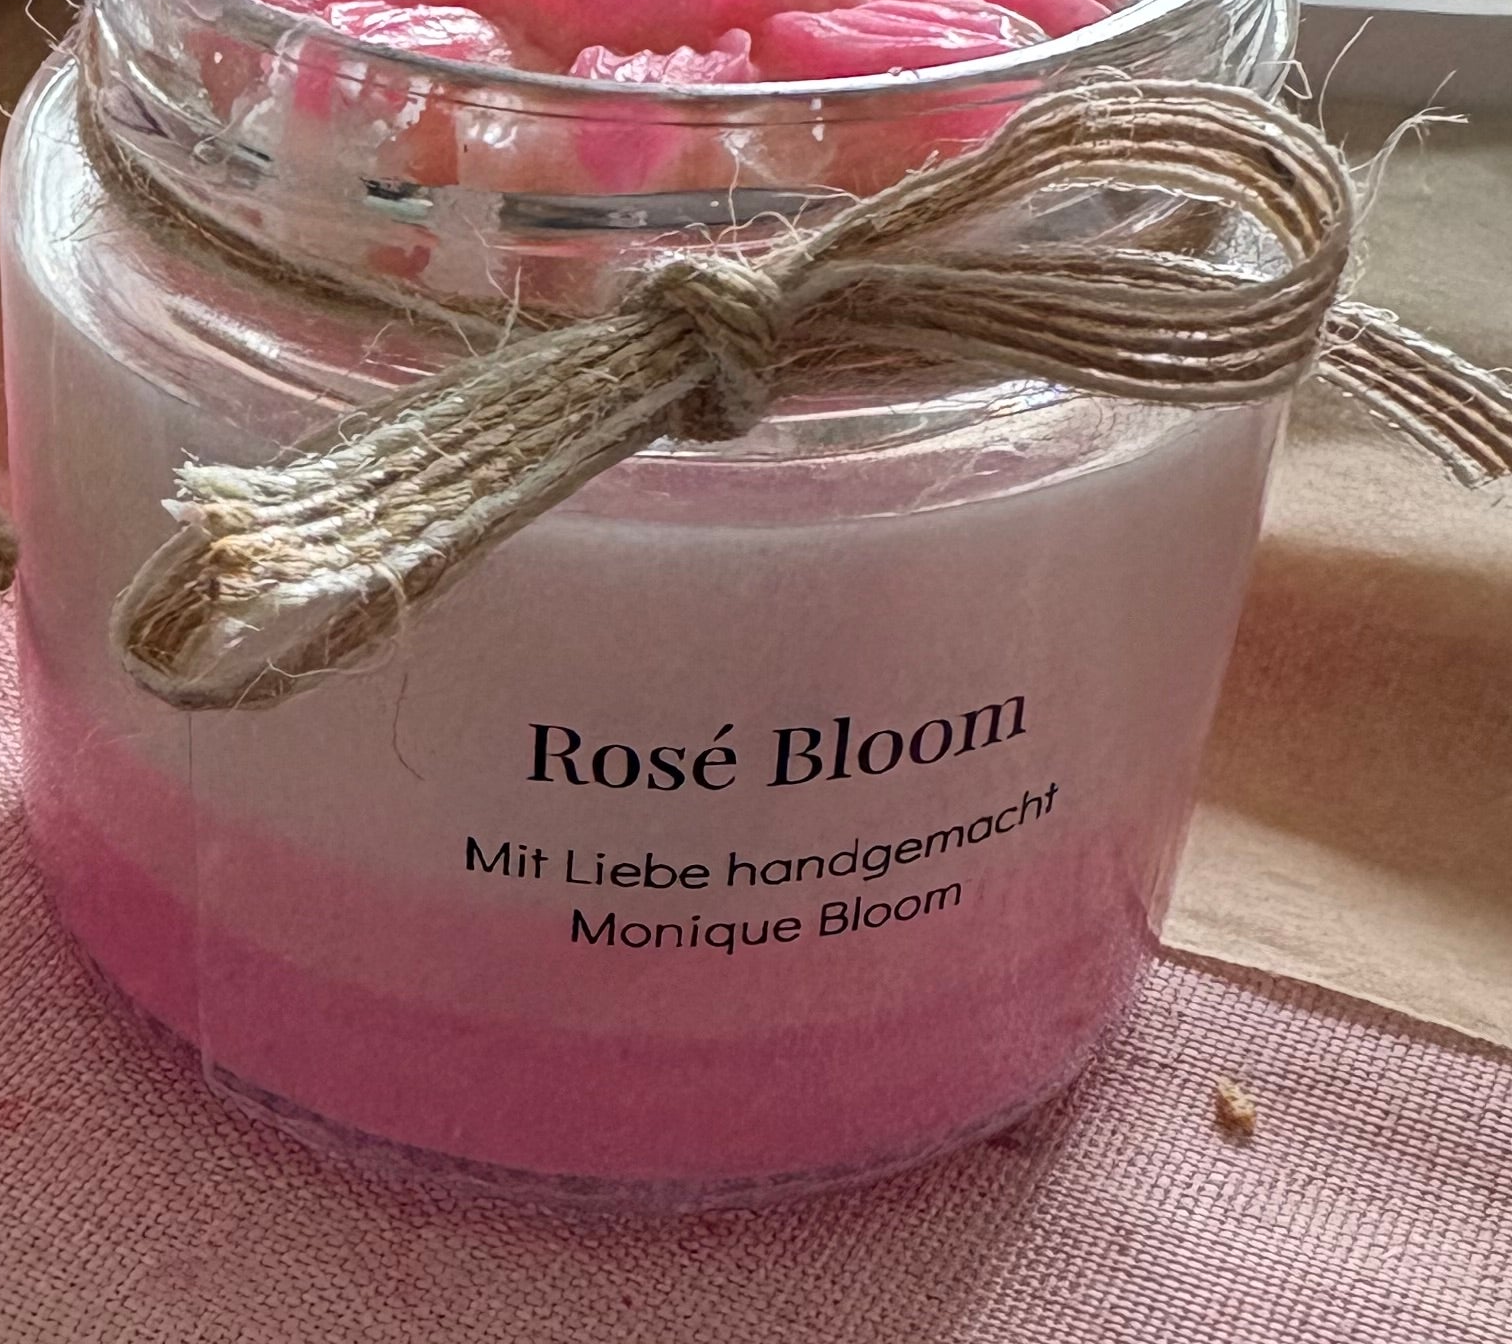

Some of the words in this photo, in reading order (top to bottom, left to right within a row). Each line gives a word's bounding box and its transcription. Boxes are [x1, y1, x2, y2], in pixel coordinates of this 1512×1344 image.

[526, 723, 737, 792] Rosé
[766, 695, 1028, 787] Bloom
[465, 836, 550, 879] Mit
[565, 849, 711, 890] Liebe
[726, 782, 1060, 887] handgemacht
[571, 908, 802, 956] Monique
[818, 882, 962, 937] Bloom
